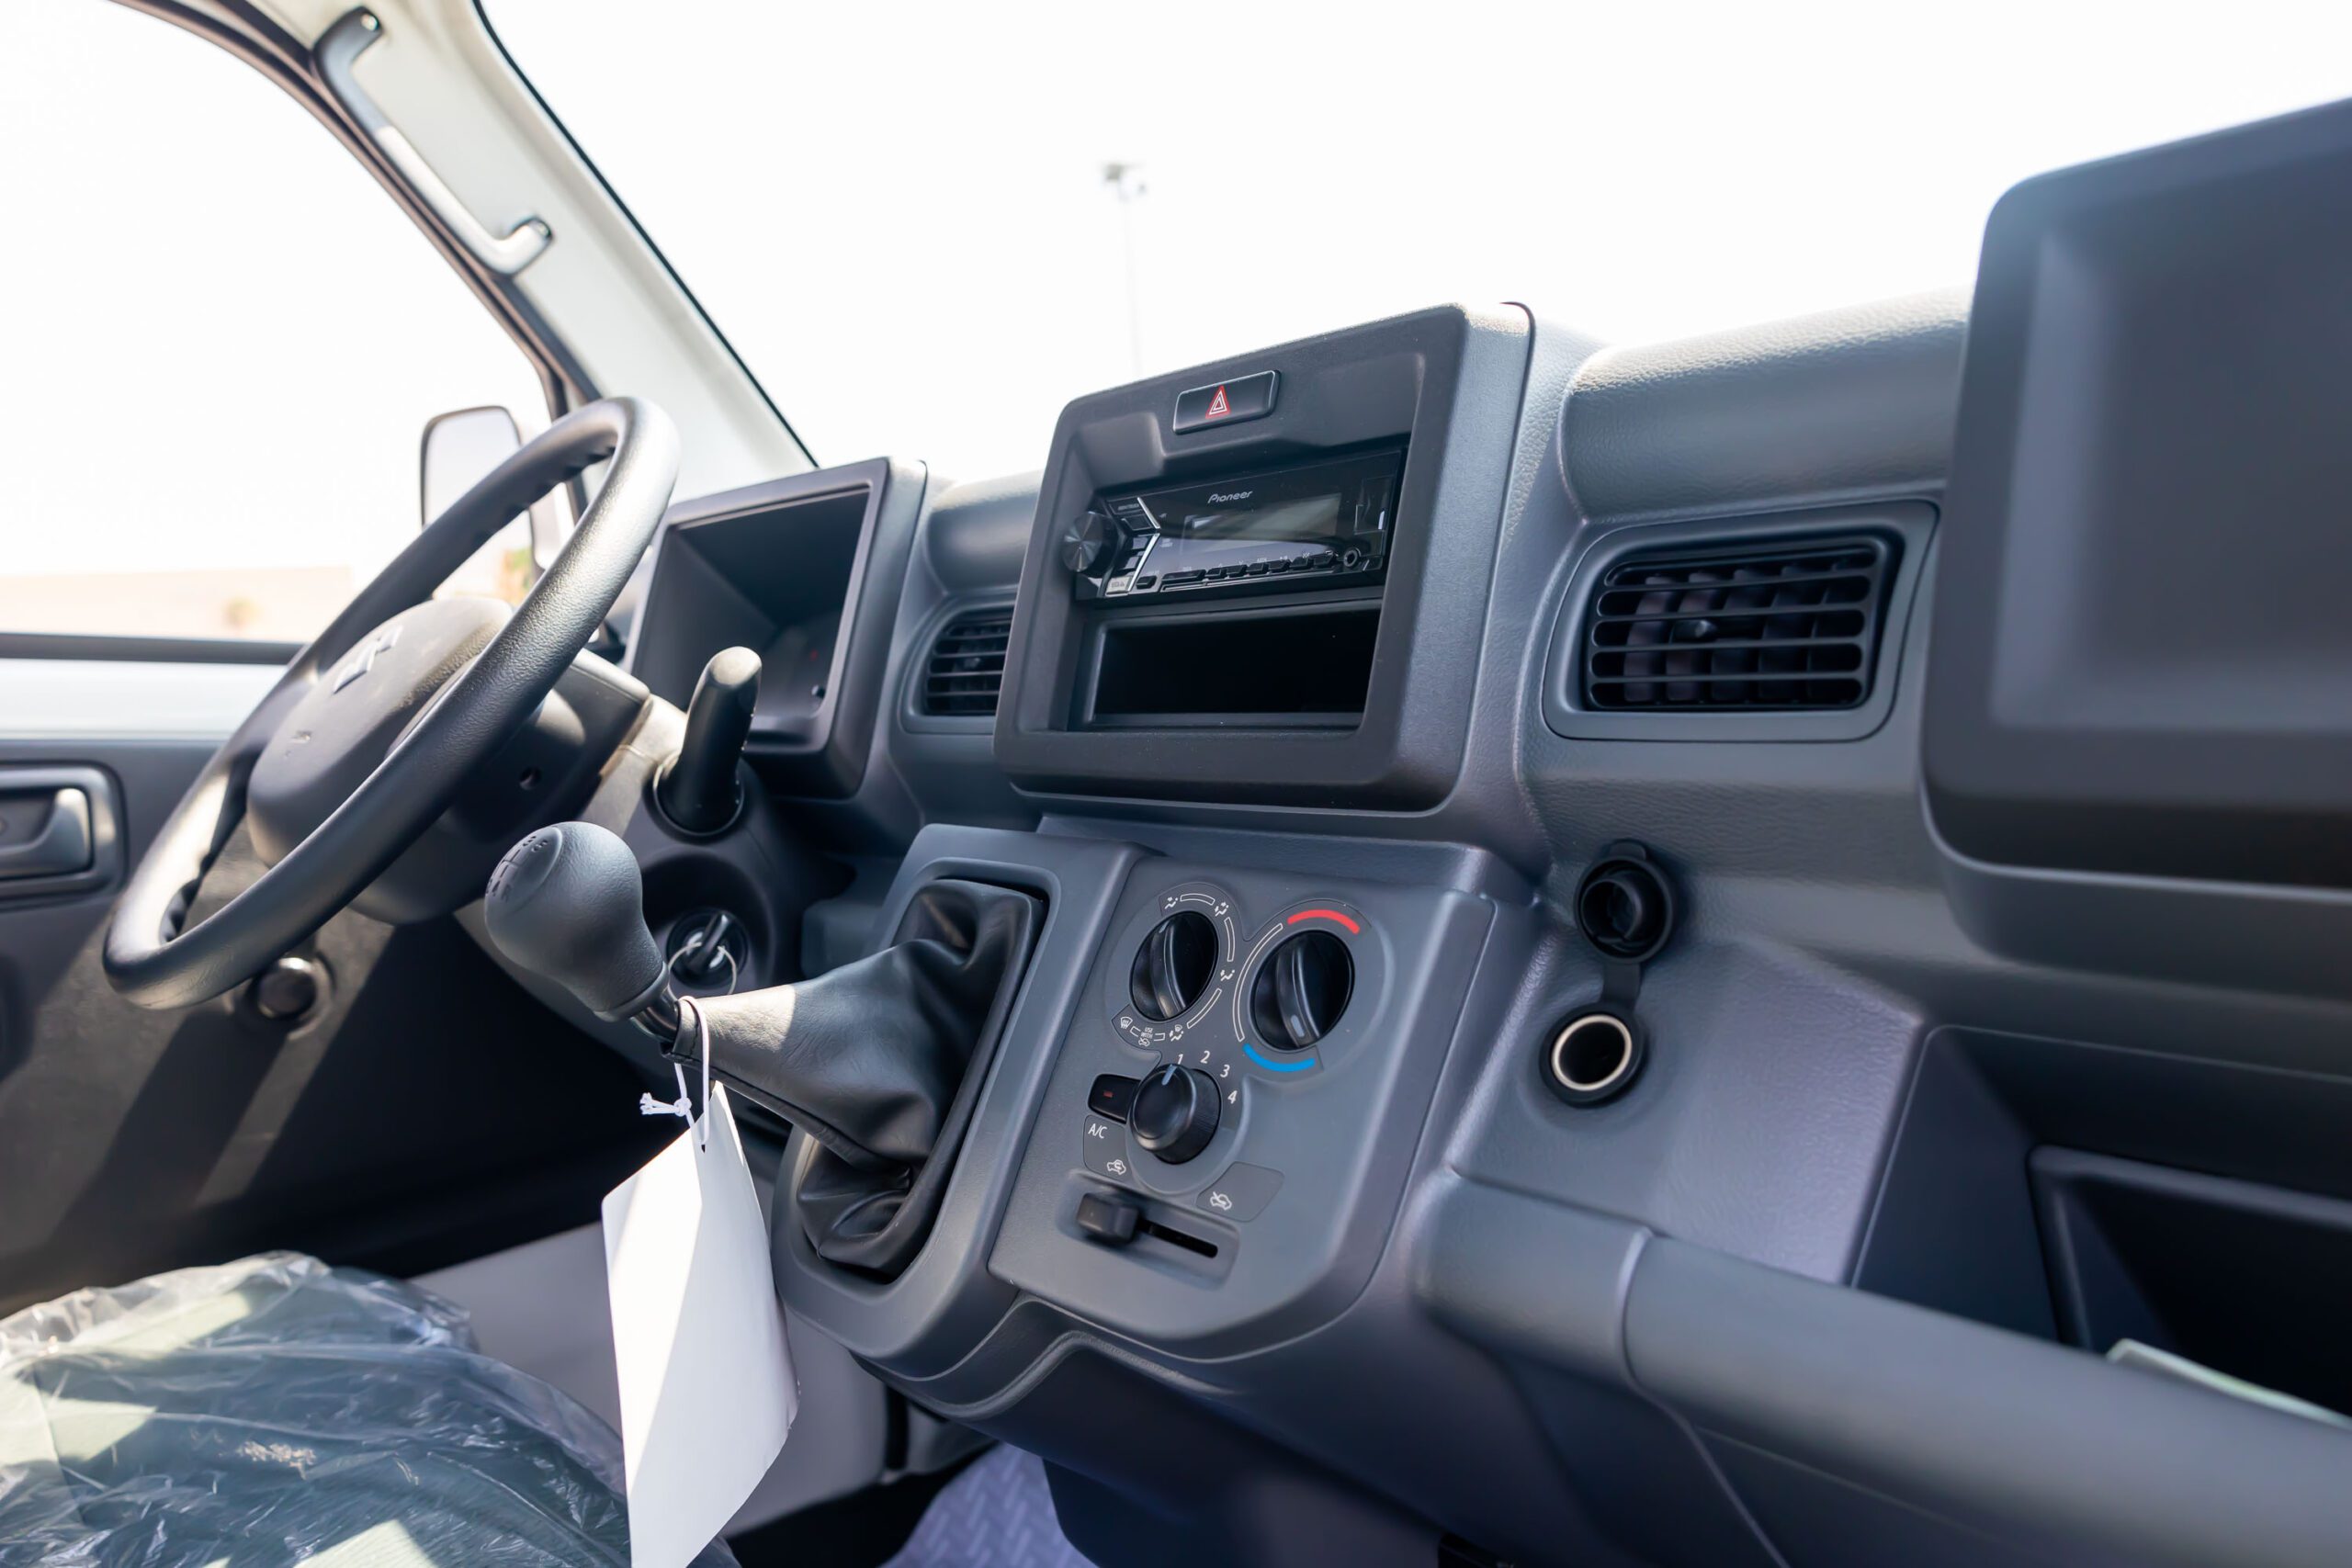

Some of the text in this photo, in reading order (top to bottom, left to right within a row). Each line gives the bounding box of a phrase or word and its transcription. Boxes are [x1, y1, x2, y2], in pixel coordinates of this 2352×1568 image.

[1207, 491, 1253, 504] Pioneer
[1177, 1050, 1238, 1104] 1 2 3 4
[1088, 1122, 1108, 1139] A/C
